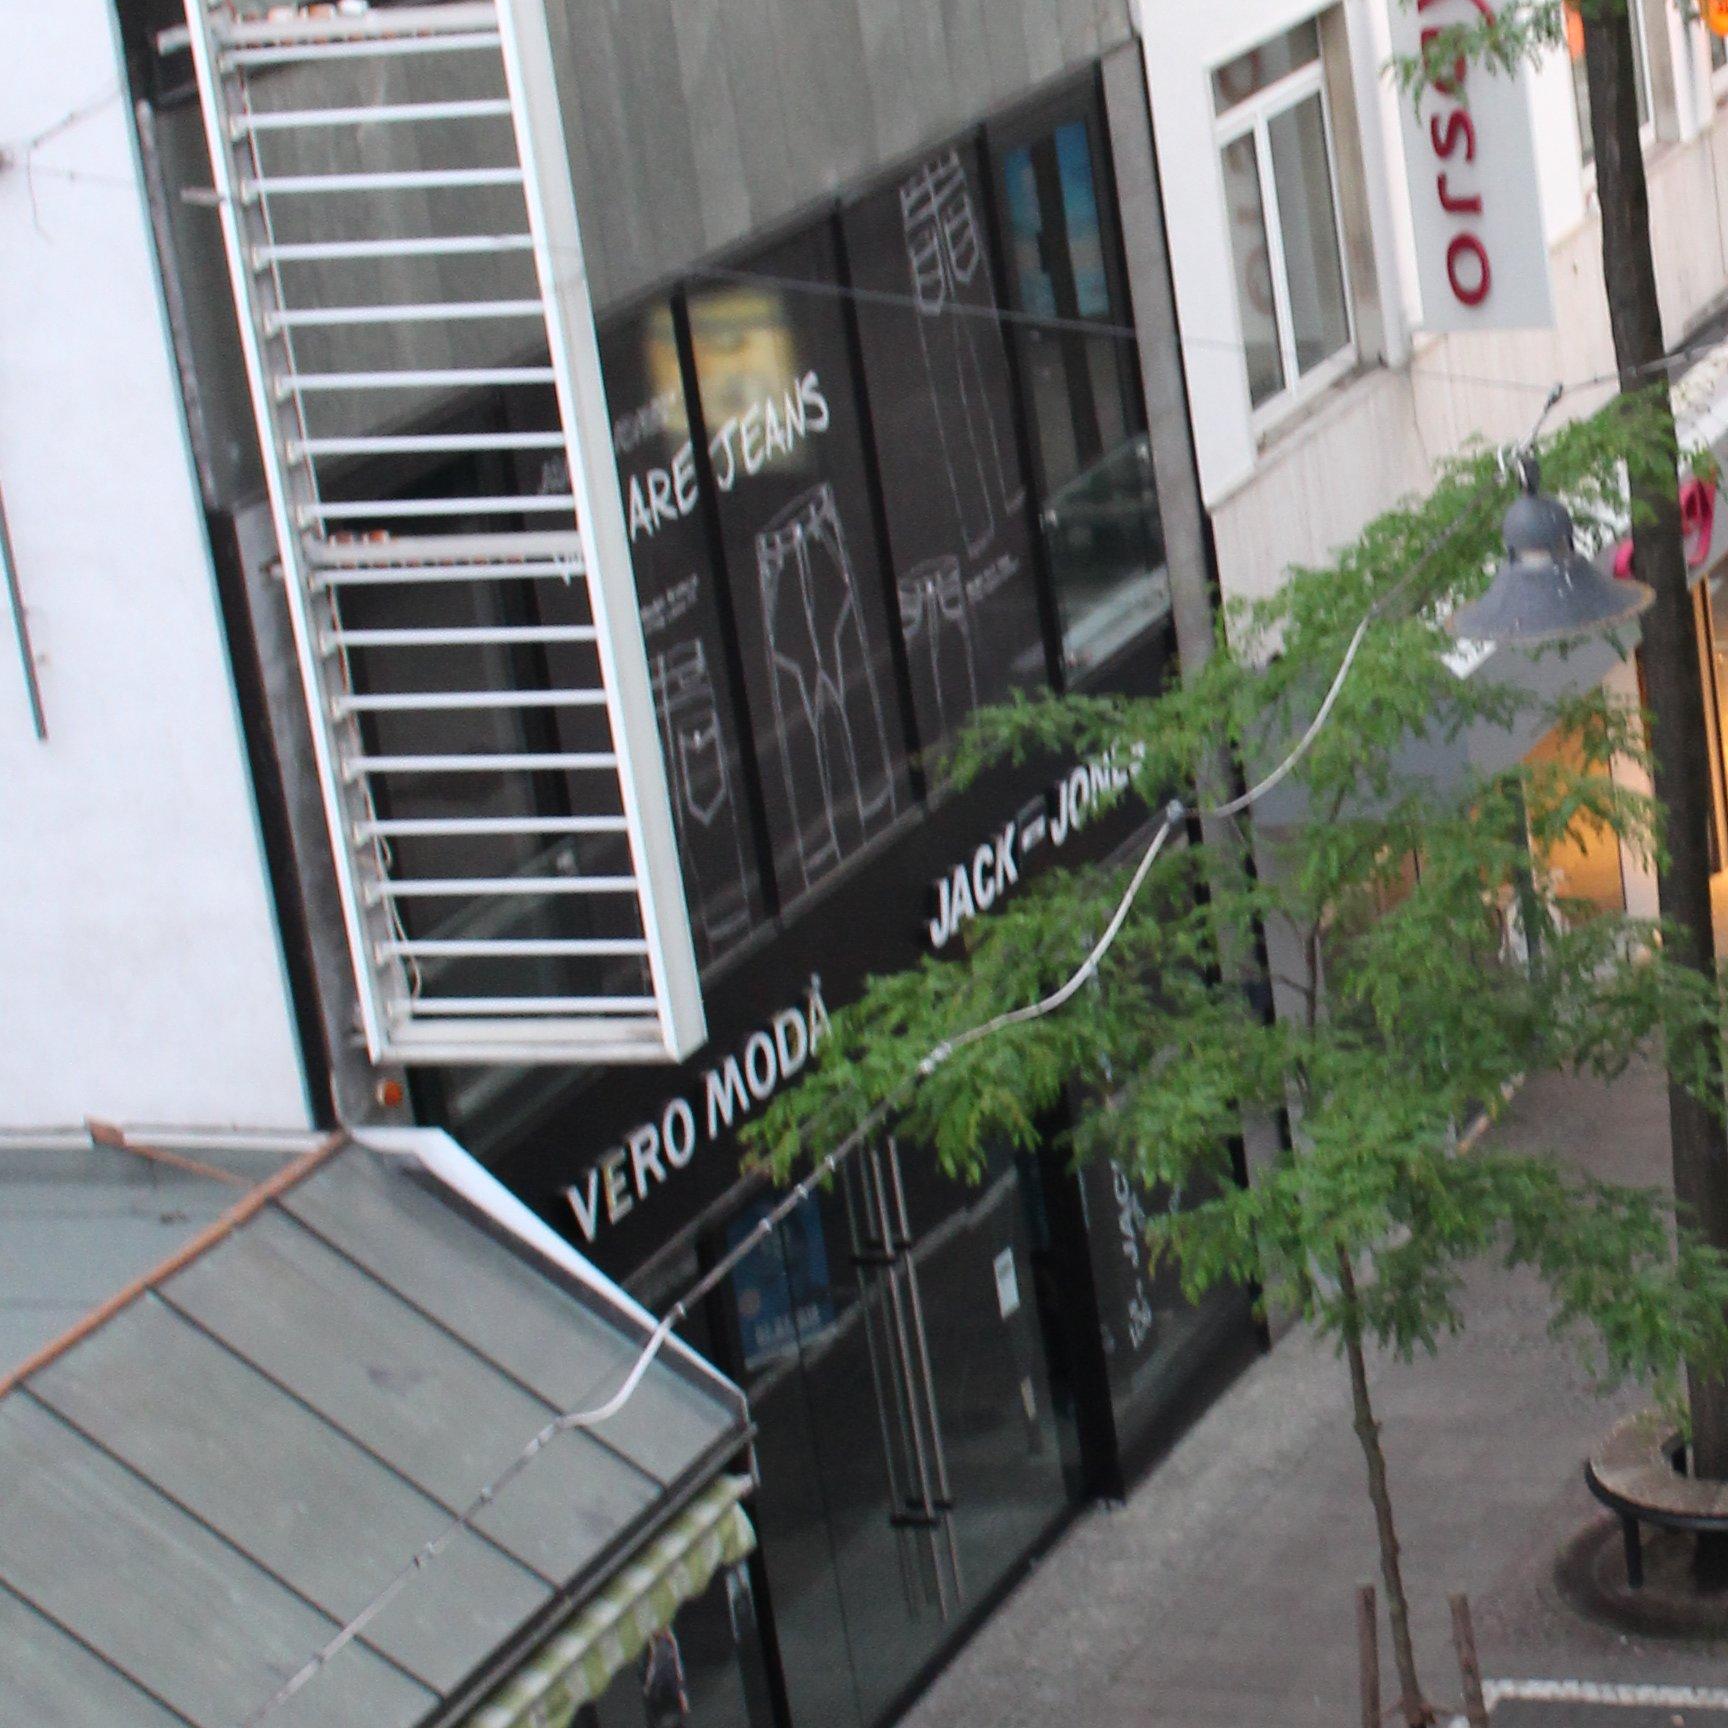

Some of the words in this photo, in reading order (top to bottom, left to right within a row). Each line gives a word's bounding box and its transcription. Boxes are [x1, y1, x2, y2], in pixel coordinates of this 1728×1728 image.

[628, 438, 700, 544] ARE
[707, 369, 830, 493] JEANS
[929, 821, 1019, 949] JACK
[566, 1098, 697, 1243] VERO
[704, 974, 834, 1141] MODA
